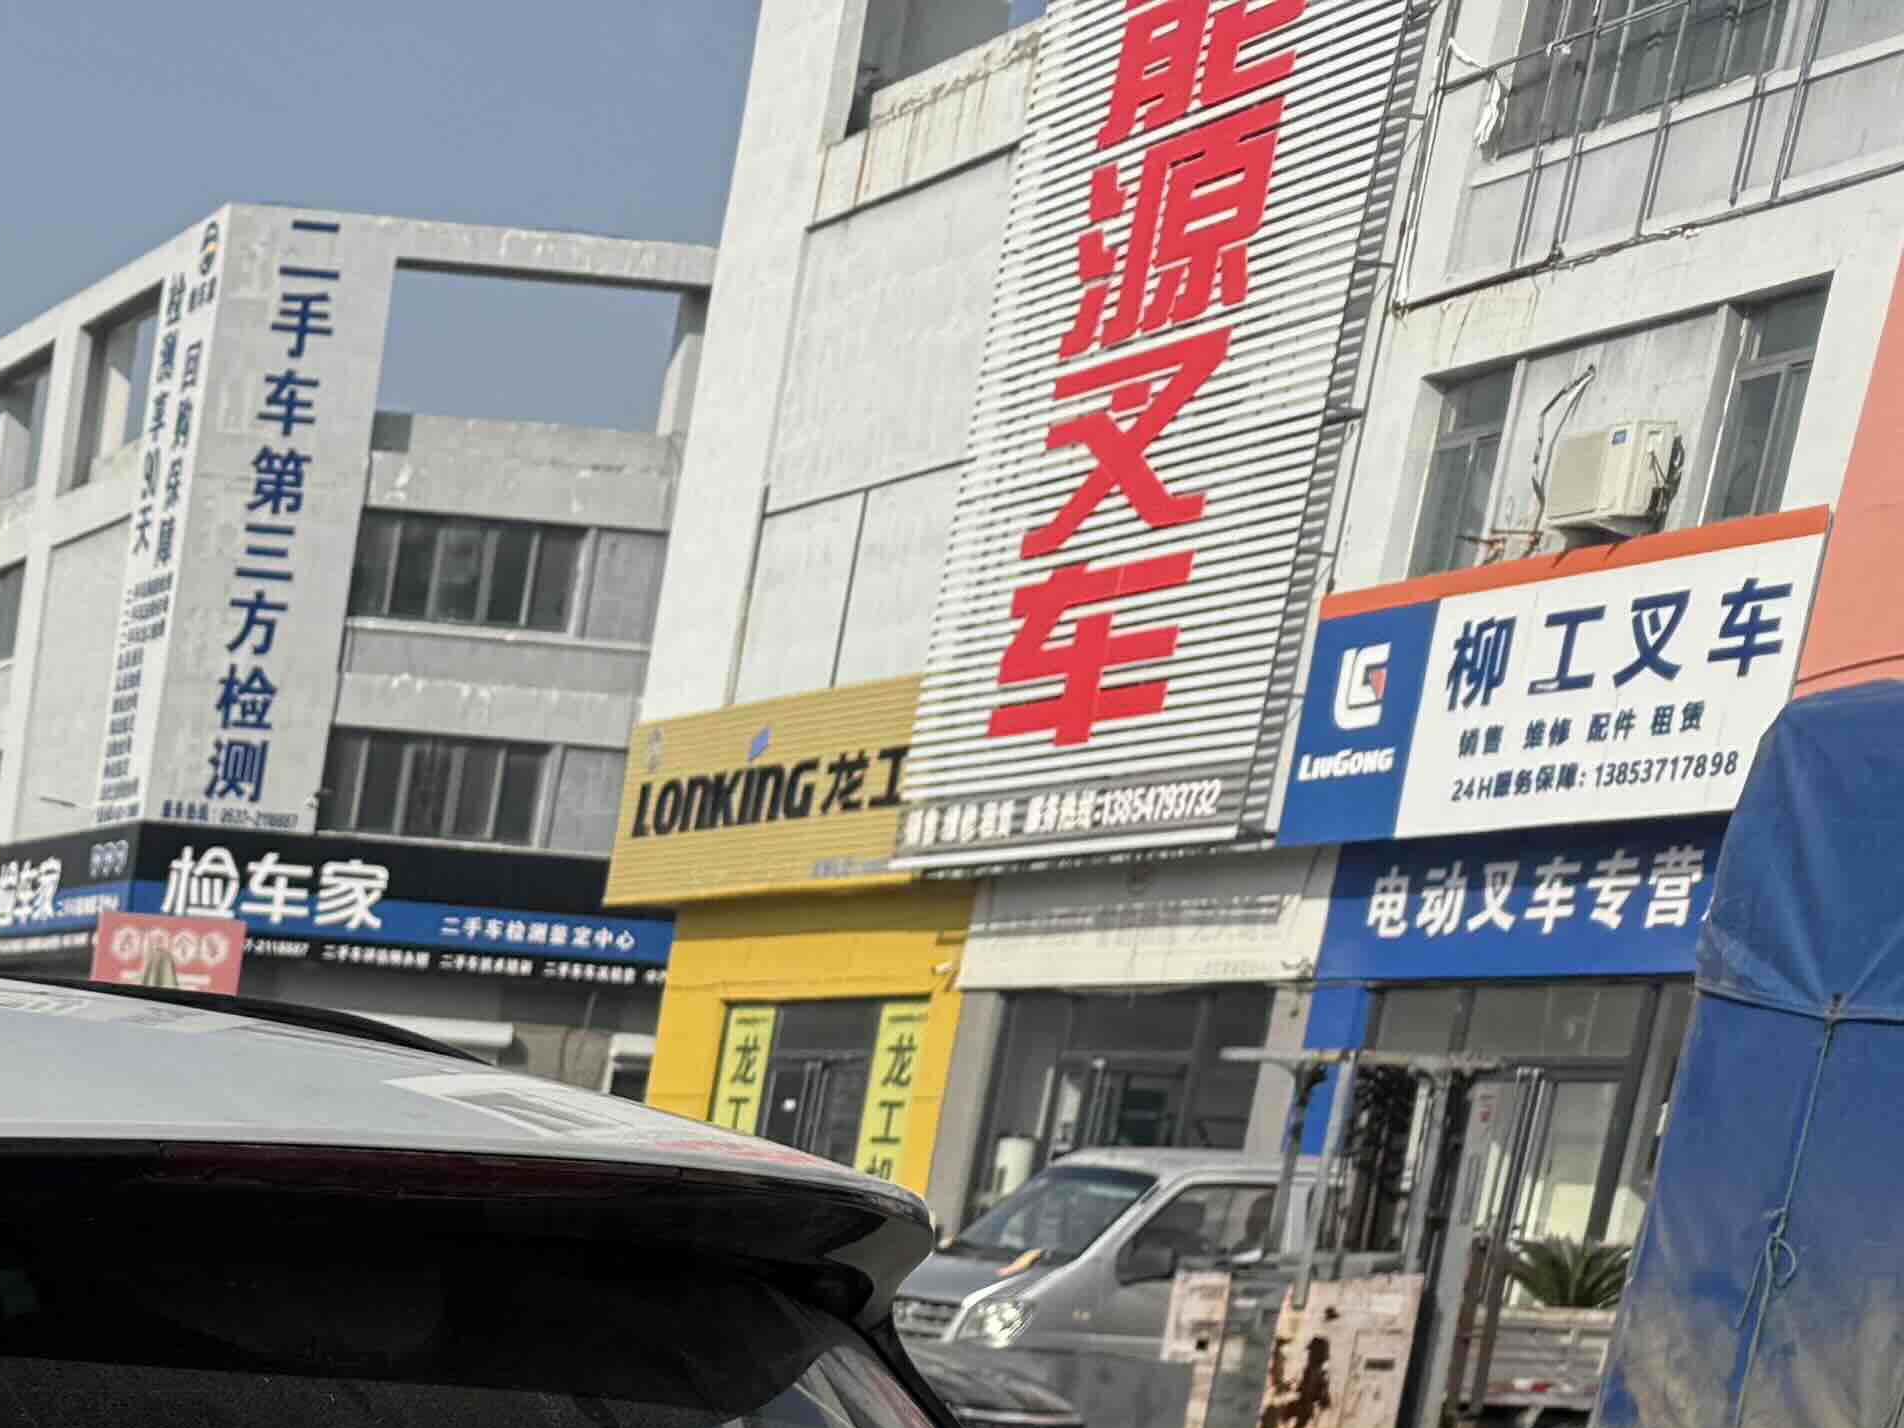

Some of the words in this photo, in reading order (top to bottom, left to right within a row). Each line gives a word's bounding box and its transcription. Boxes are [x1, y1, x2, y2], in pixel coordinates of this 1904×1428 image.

[205, 217, 341, 803] 二手车第三方检测
[1444, 577, 1794, 712] 柳工叉车
[1457, 724, 1501, 759] 销售
[1523, 717, 1571, 751] 维修
[1587, 709, 1636, 743] 配件
[1651, 701, 1705, 737] 租赁
[1593, 750, 1738, 789] 13853717898
[161, 845, 389, 930] 检车家
[1365, 844, 1713, 938] 电动叉车专营
